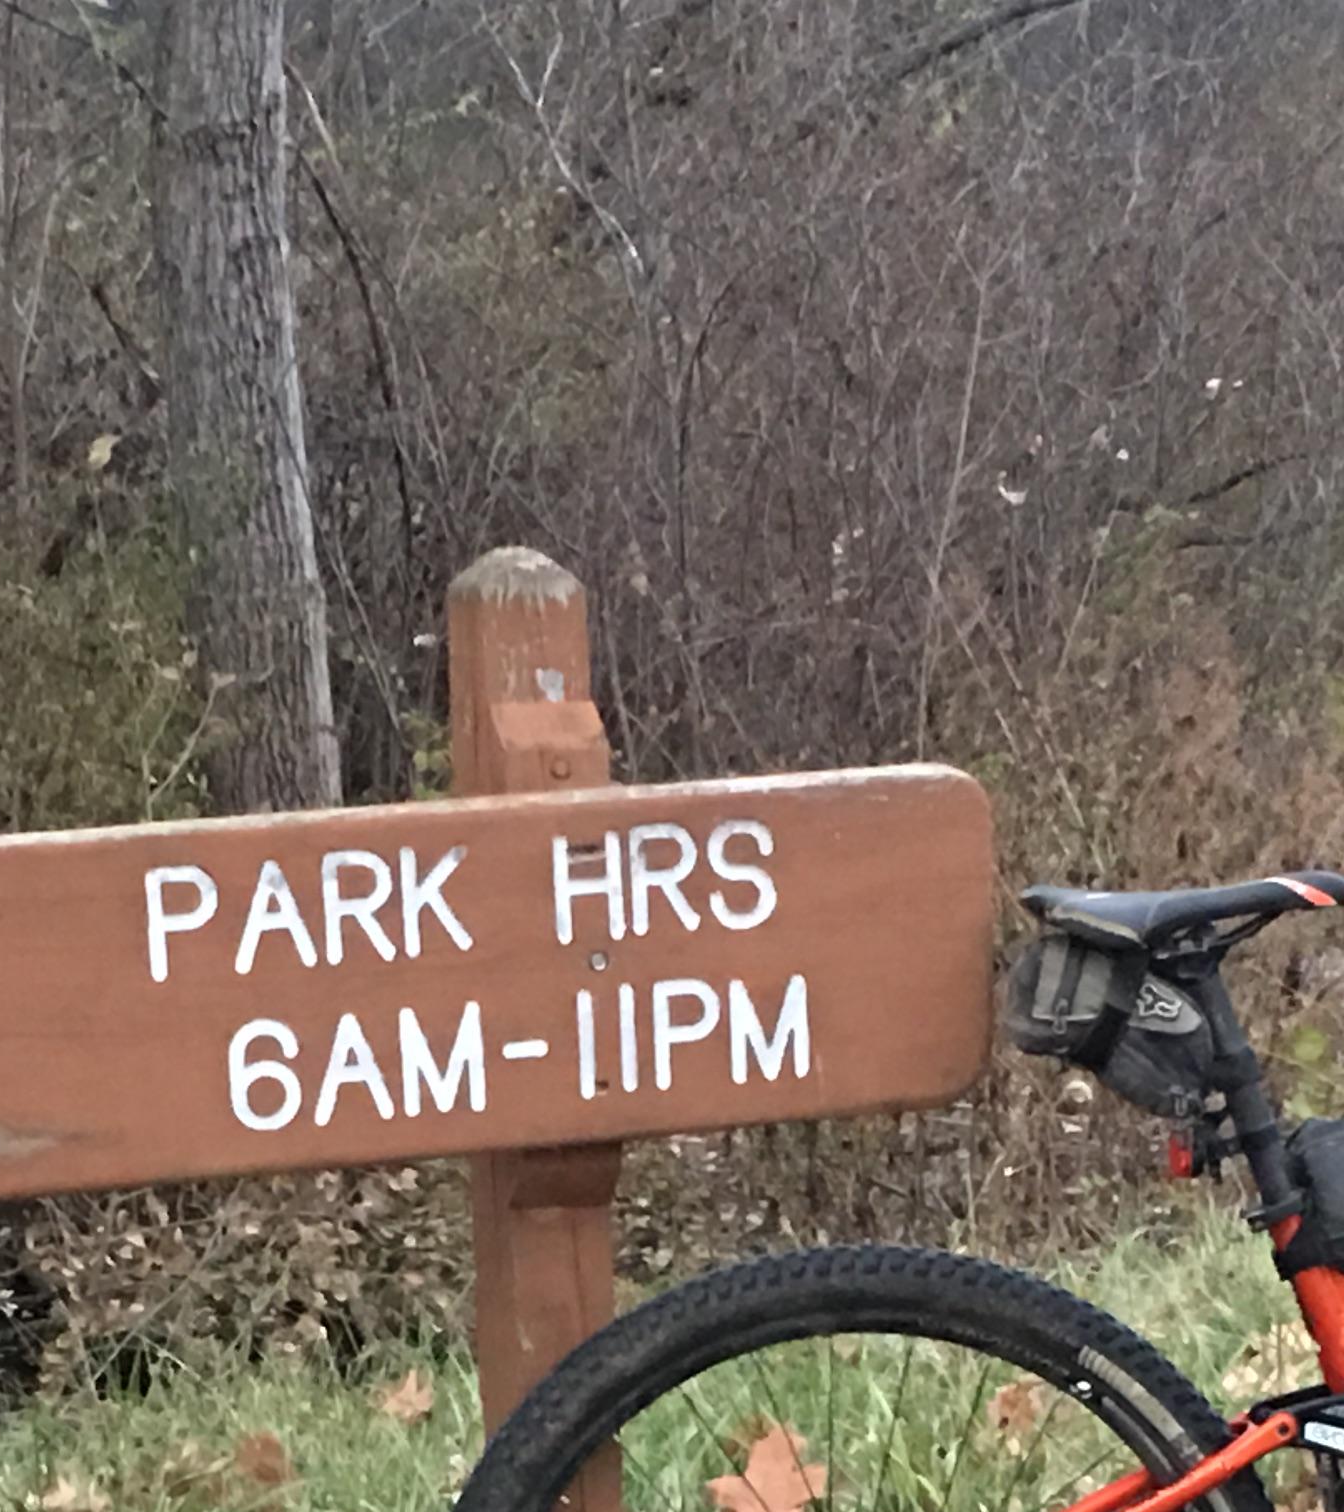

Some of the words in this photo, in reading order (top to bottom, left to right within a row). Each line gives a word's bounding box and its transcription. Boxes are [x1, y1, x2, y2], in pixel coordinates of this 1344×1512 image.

[145, 844, 474, 983] PARK
[552, 819, 779, 945] HRS
[228, 974, 811, 1131] 6AM-11PM
